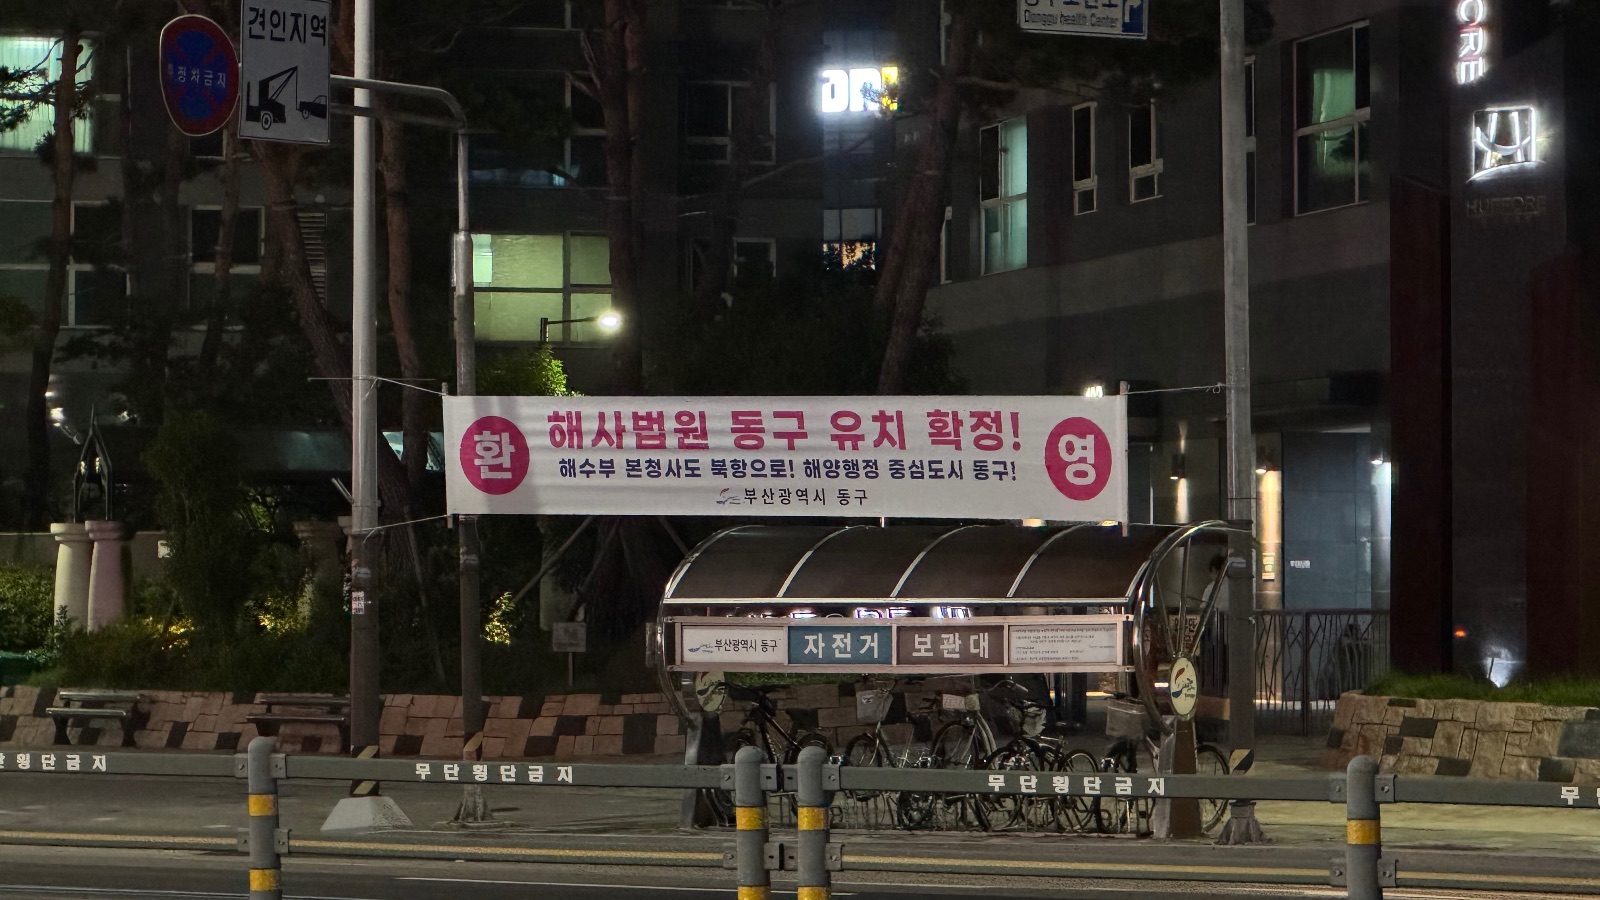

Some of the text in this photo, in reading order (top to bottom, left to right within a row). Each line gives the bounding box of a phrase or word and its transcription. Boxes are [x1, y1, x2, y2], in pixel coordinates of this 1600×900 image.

[248, 7, 327, 46] 견인지역
[547, 409, 1021, 451] 해사법원 동구 유치 확정!
[473, 430, 516, 480] 환
[1058, 434, 1097, 486] 영
[558, 458, 1017, 481] 해수부 본청사도 북항으로! 해양행정 중심도시 동구!
[744, 488, 869, 506] 부산광역시 동구
[714, 639, 757, 653] 부산광역시
[803, 632, 989, 659] 자전거 보관대
[415, 763, 574, 784] 무단횡단금지
[988, 774, 1165, 796] 무단횡단금지
